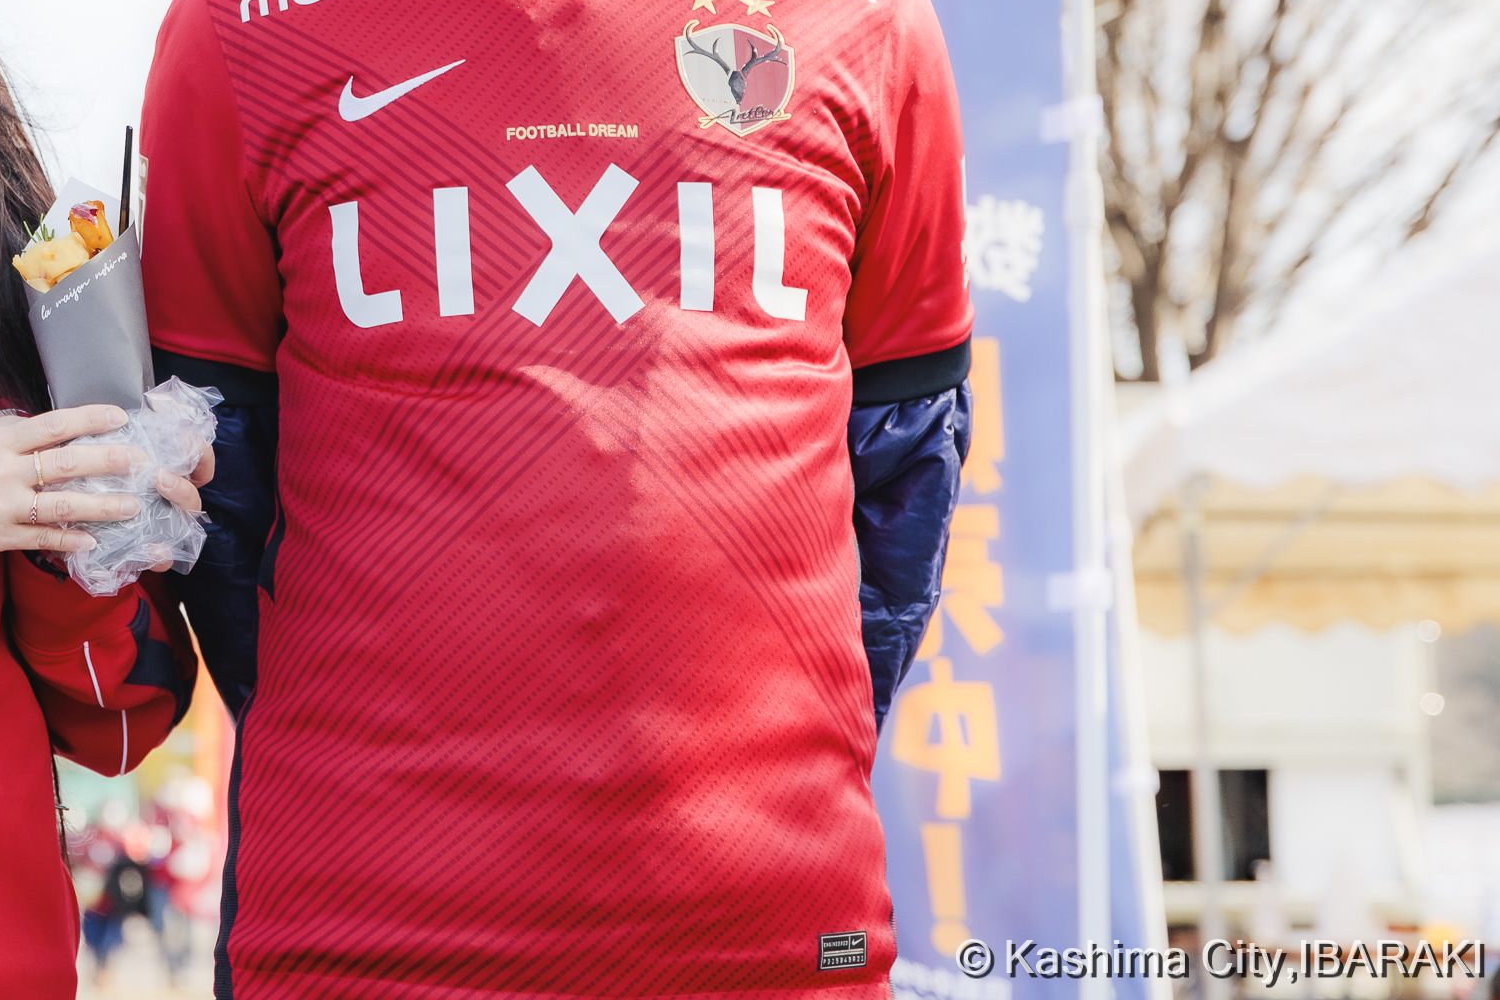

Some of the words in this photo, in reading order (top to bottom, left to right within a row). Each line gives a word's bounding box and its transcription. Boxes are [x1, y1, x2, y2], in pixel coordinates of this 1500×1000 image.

[506, 123, 586, 141] FOOTBALL
[588, 124, 639, 138] DREAM
[329, 162, 809, 328] LIXIL
[40, 304, 52, 321] la
[55, 277, 91, 308] maison
